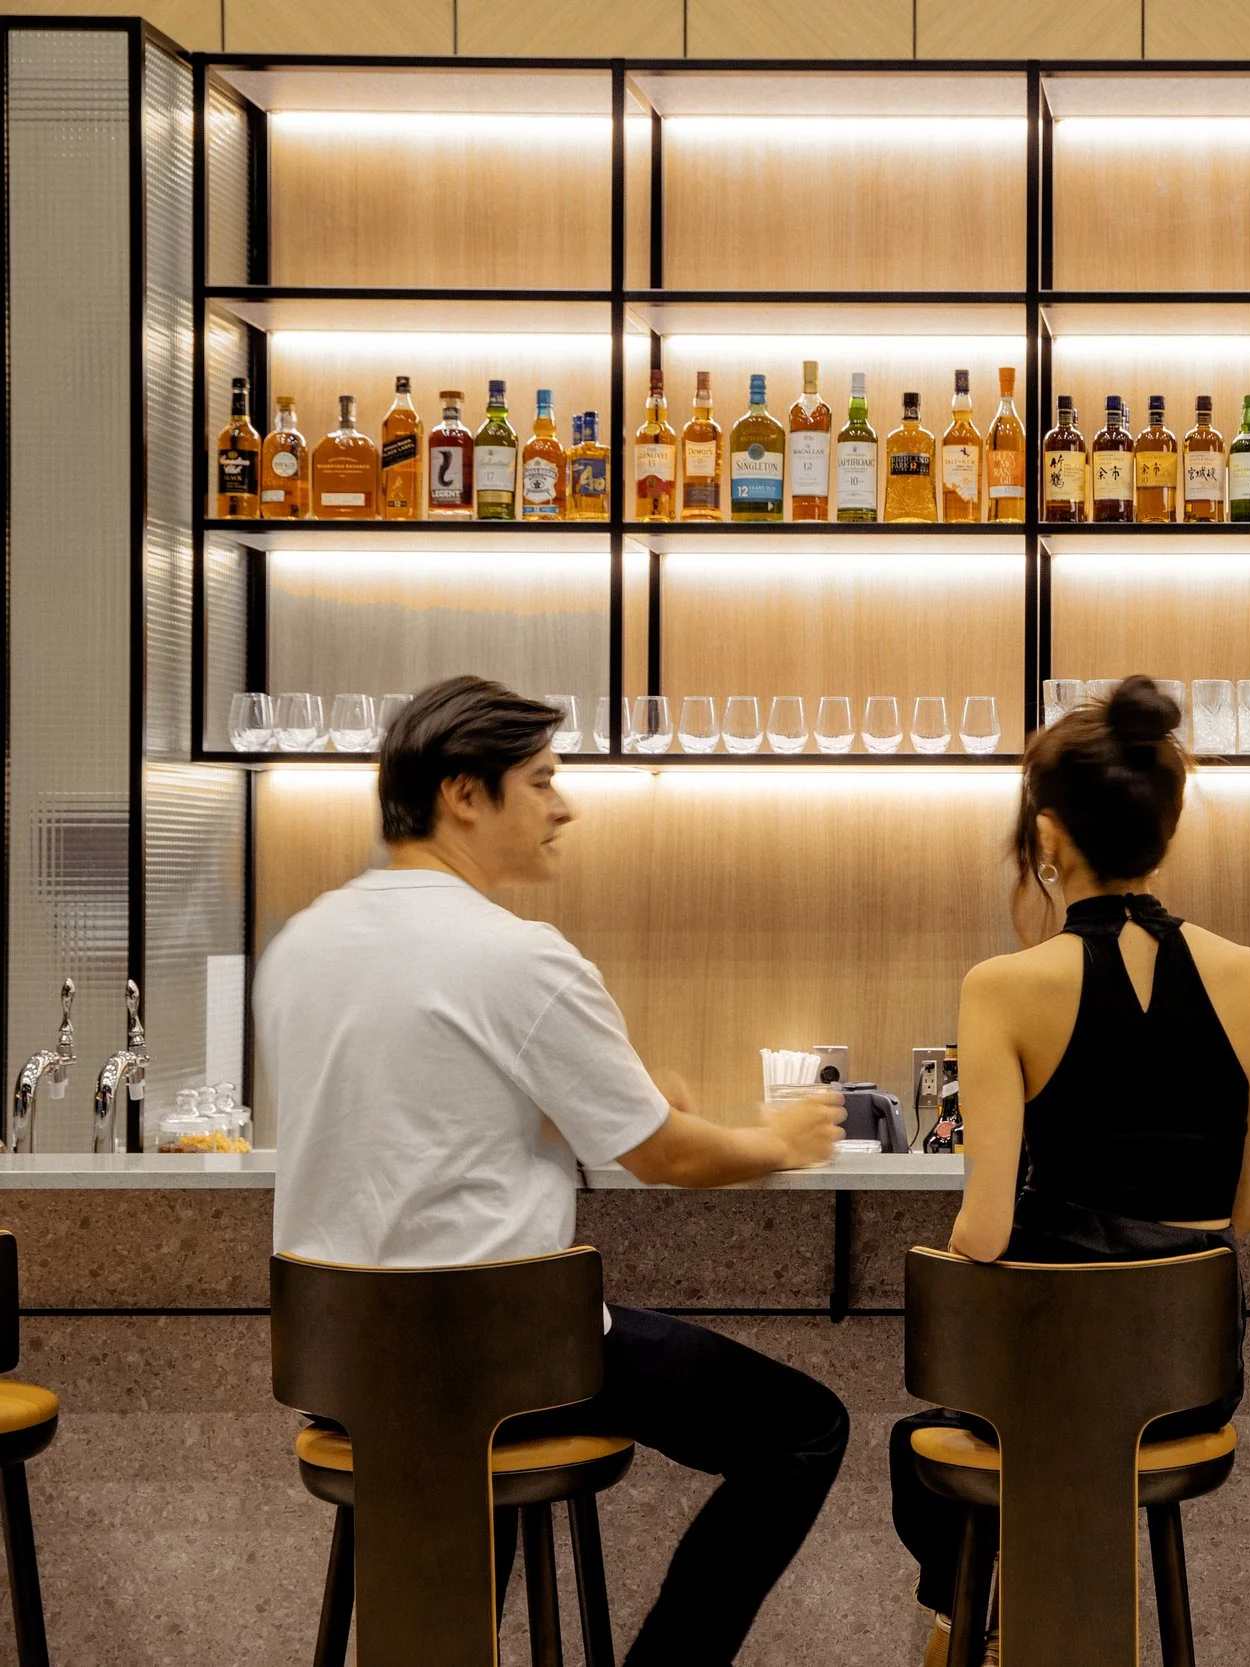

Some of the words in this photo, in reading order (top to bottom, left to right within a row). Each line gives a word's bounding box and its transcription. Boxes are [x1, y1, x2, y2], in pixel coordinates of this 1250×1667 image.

[993, 452, 1016, 460] GLEN
[736, 460, 778, 472] SINGLETON
[803, 462, 813, 470] 12
[850, 477, 858, 486] 10
[432, 490, 461, 498] LEGENT
[737, 485, 749, 497] 12
